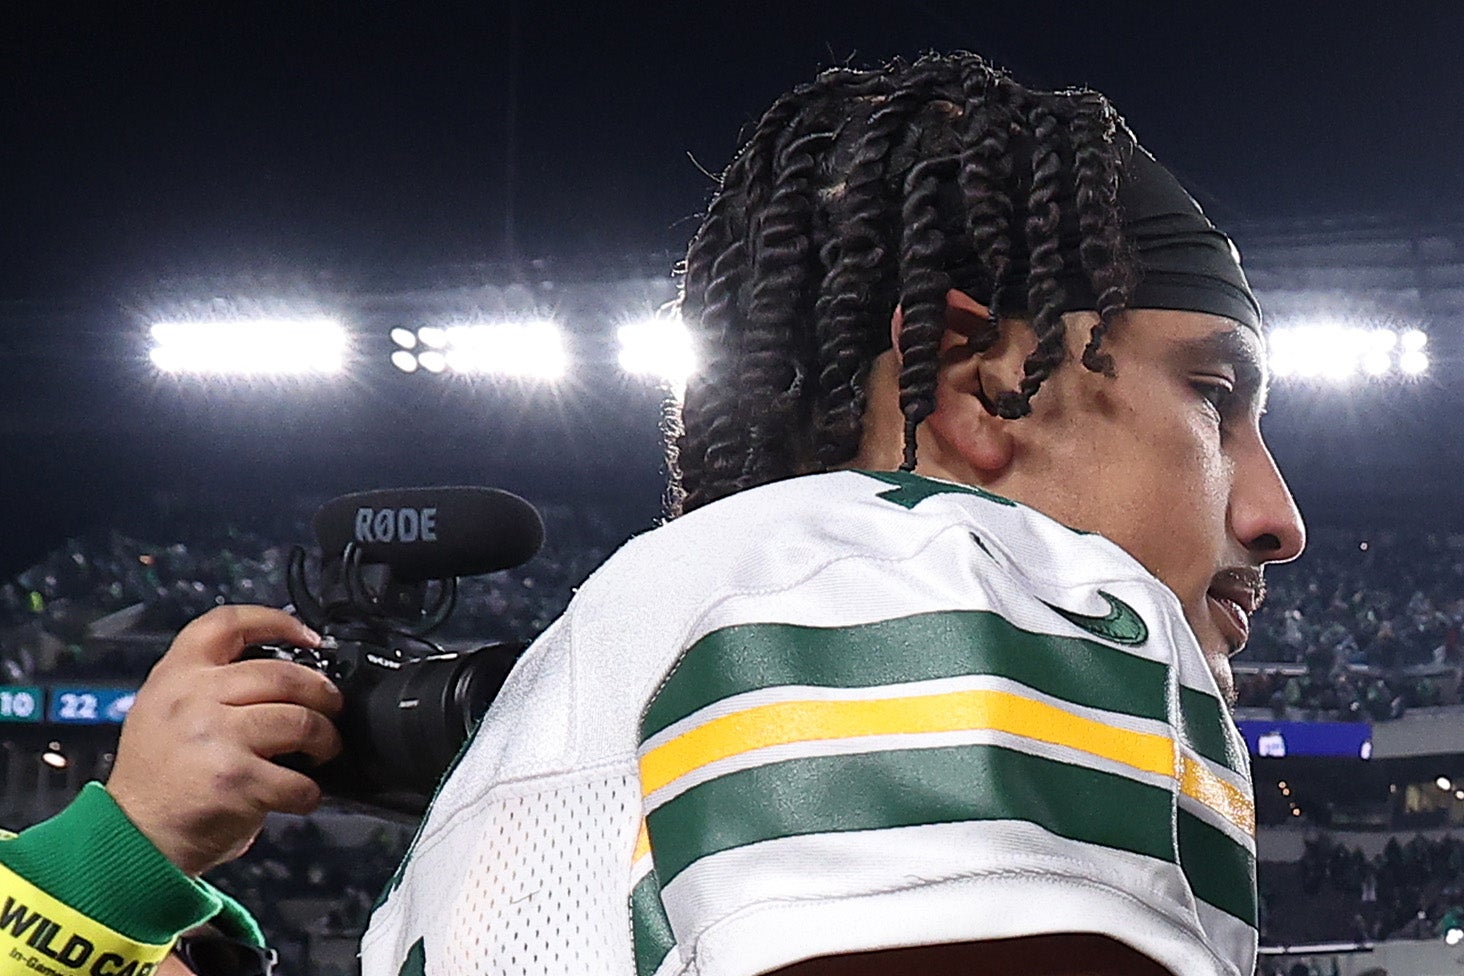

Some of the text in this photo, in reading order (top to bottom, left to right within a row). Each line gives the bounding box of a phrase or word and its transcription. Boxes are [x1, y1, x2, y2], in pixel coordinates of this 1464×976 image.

[355, 507, 438, 542] RØDE
[0, 691, 35, 717] 10
[59, 693, 98, 719] 22
[0, 896, 95, 969] WILD
